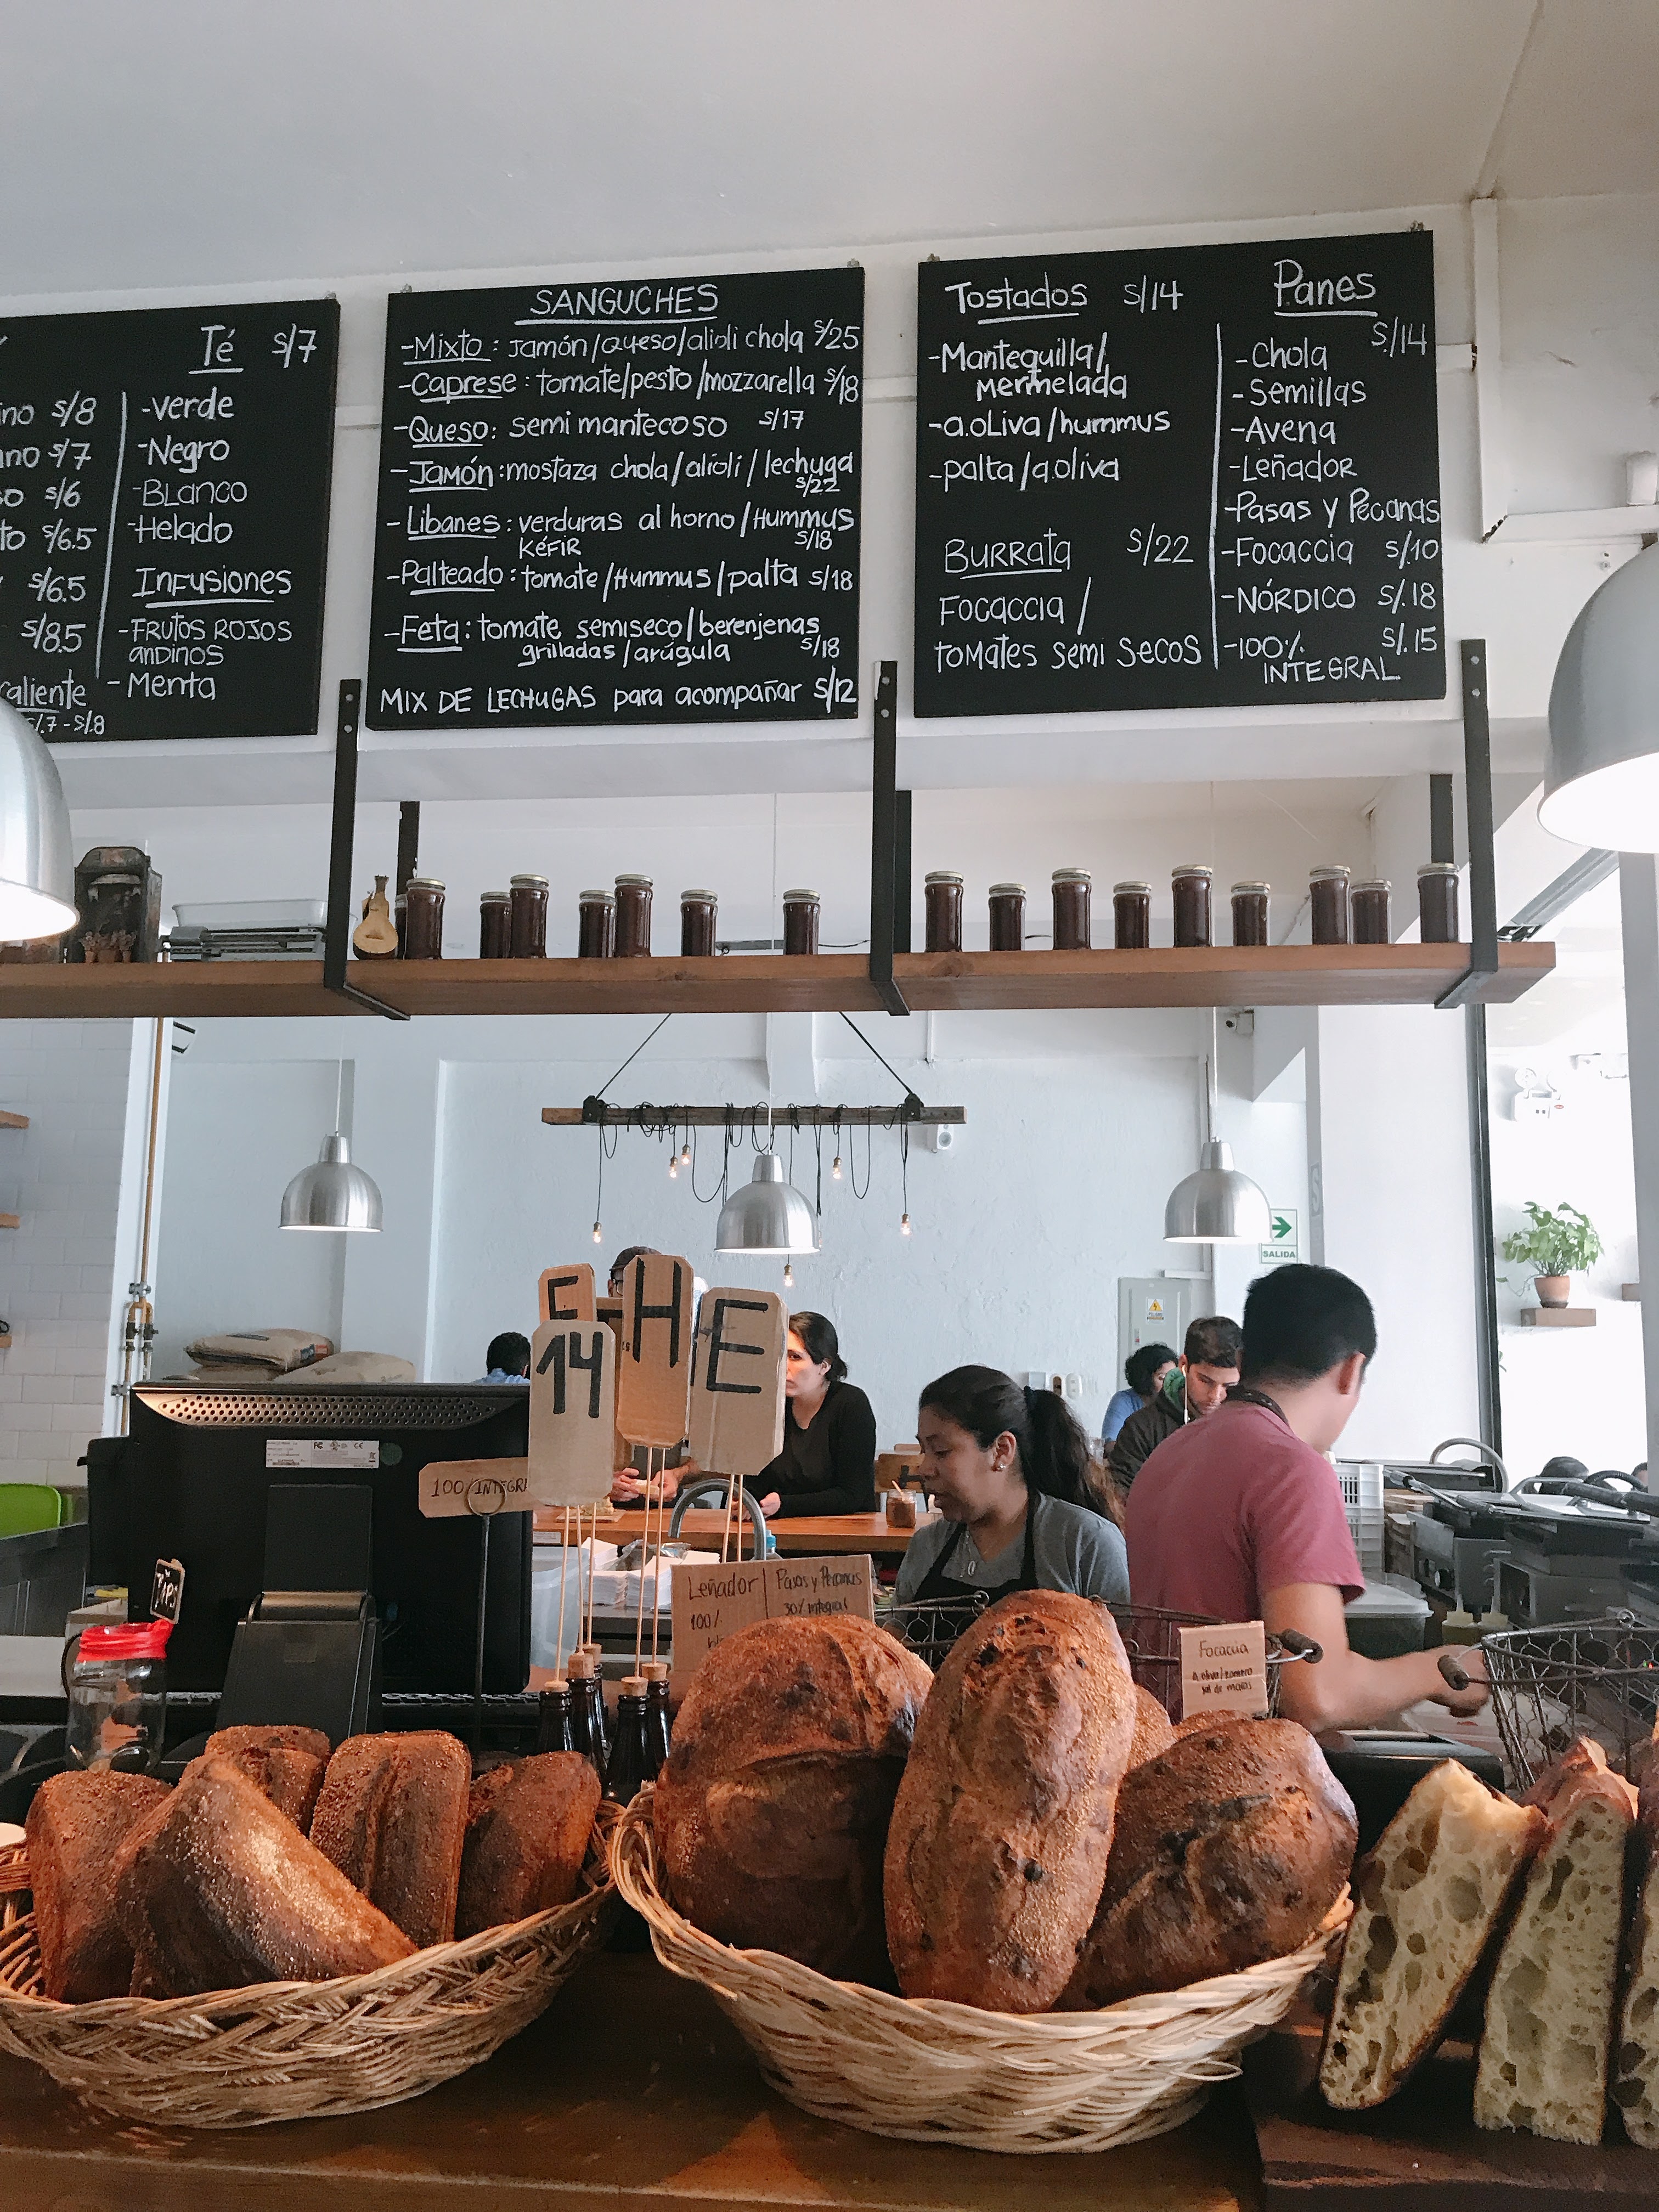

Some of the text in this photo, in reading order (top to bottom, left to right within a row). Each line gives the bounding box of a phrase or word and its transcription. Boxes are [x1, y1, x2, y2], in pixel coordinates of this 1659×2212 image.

[528, 282, 718, 315] SANGUCHES
[945, 272, 1087, 314] Tostados
[1274, 259, 1375, 307] Panes
[201, 325, 235, 366] Té
[746, 320, 803, 353] chola
[509, 411, 571, 437] semi
[579, 408, 727, 437] mantecoso
[765, 447, 853, 483] lechuga
[519, 506, 622, 533] verduras
[639, 504, 660, 530] al
[1323, 498, 1338, 528] y
[1350, 488, 1440, 523] Pecanas
[215, 619, 292, 641] ROJOS
[477, 611, 562, 641] tomate
[1264, 655, 1401, 684] INTEGRAL
[381, 688, 427, 714] MIX
[438, 687, 472, 714] DE
[614, 689, 662, 712] para
[675, 680, 803, 708] acompañar
[633, 1259, 682, 1369] H
[707, 1299, 769, 1394] E
[537, 1331, 603, 1419] 14
[688, 1572, 758, 1600] Leñador
[776, 1568, 809, 1590] Pasas
[811, 1576, 817, 1593] y
